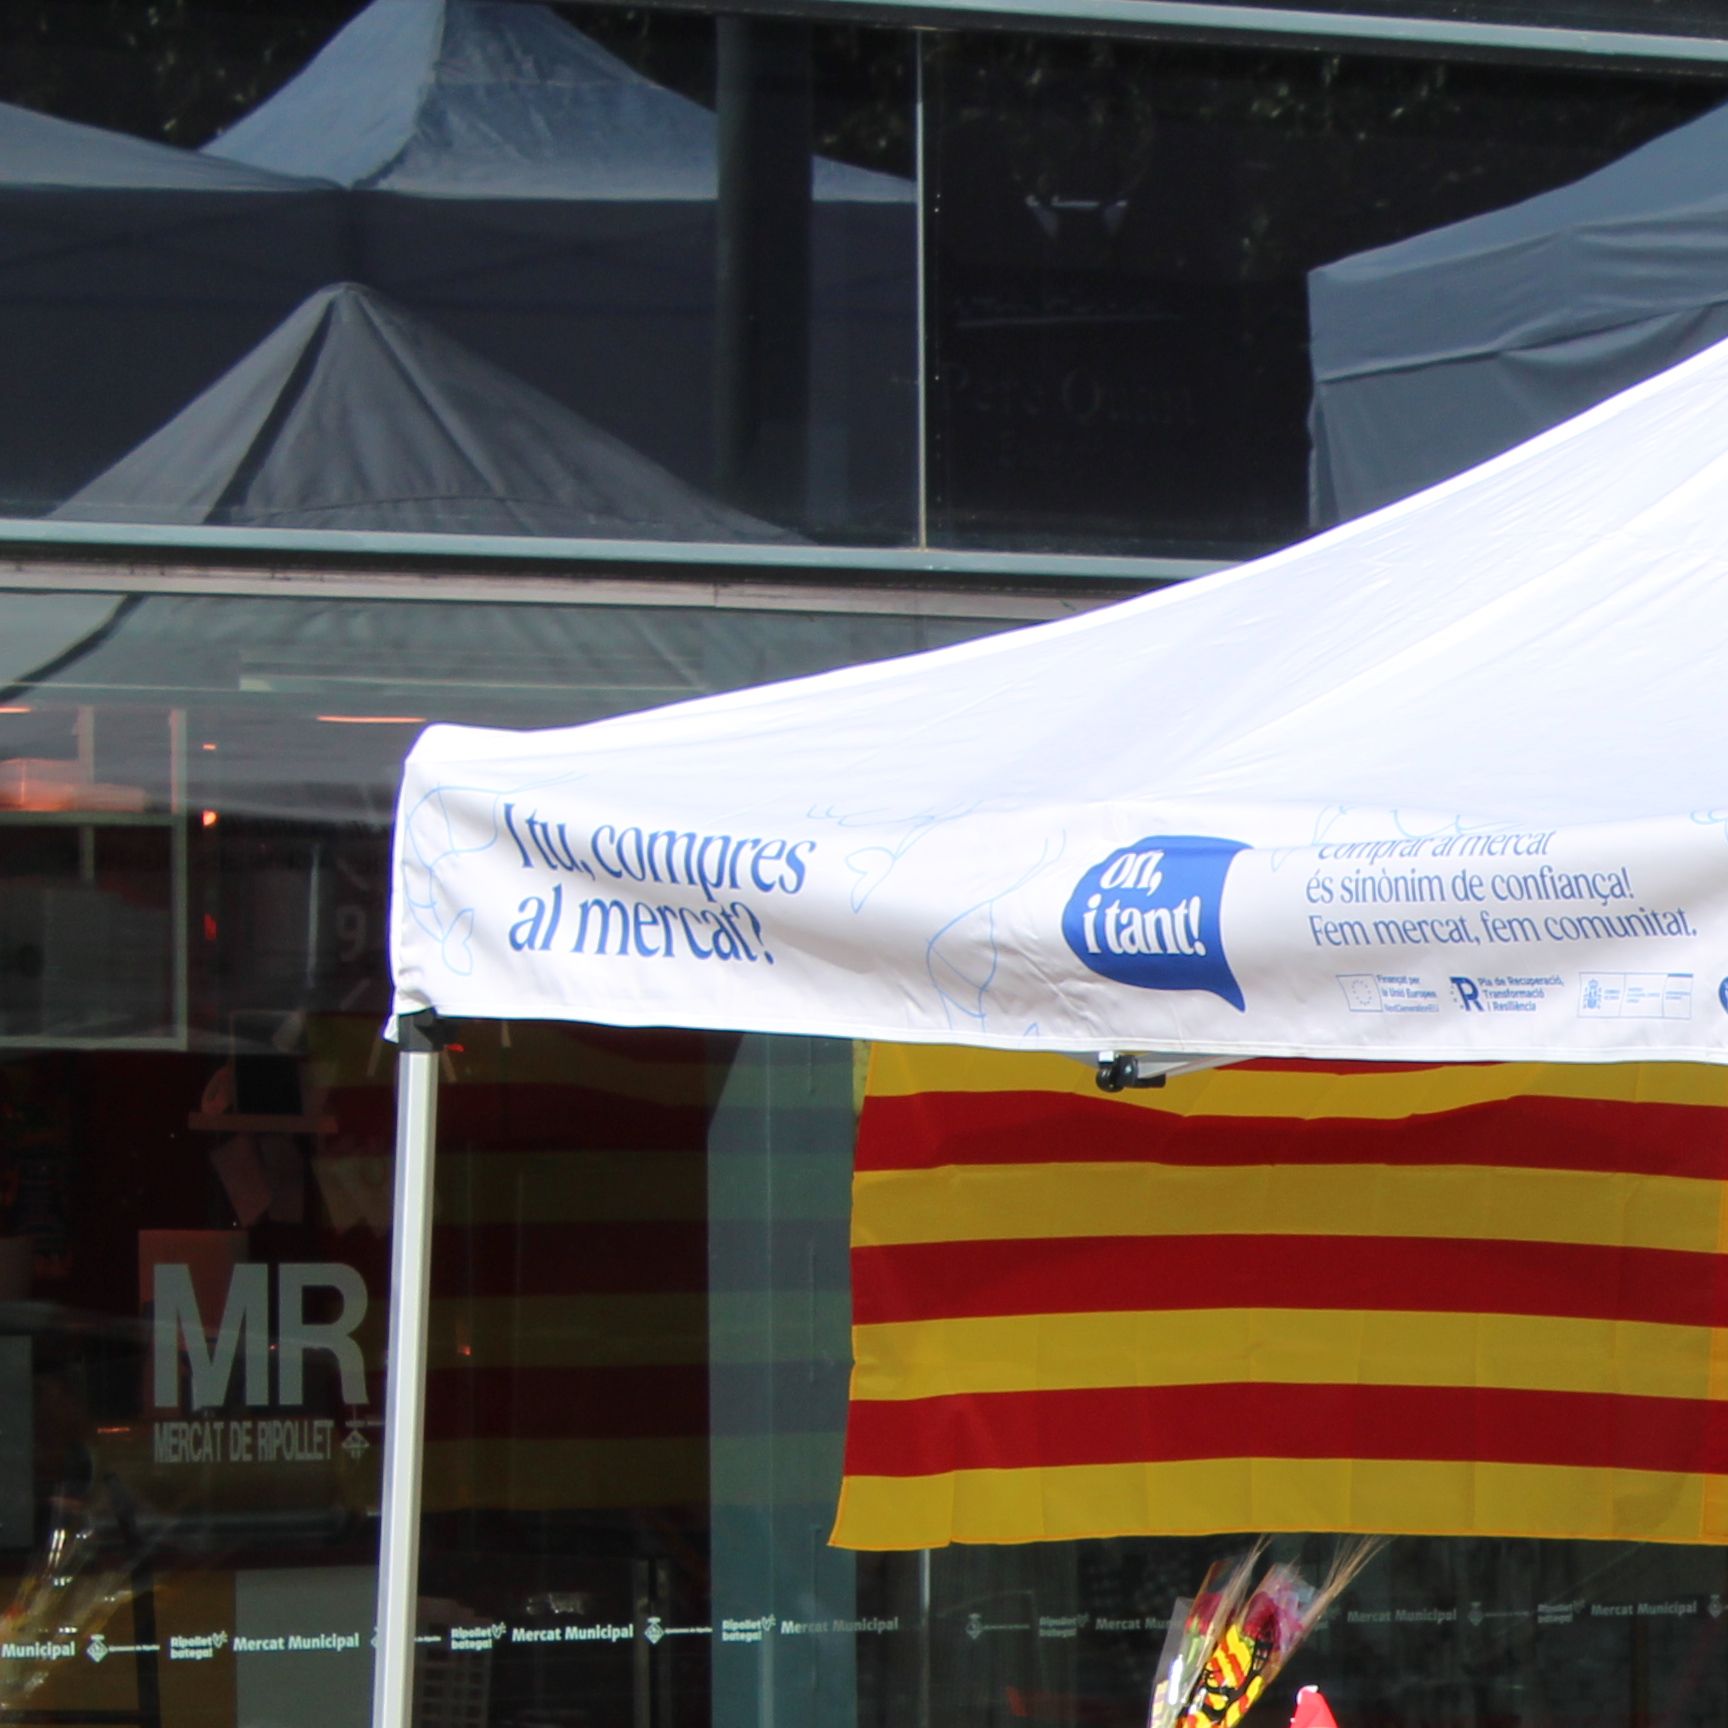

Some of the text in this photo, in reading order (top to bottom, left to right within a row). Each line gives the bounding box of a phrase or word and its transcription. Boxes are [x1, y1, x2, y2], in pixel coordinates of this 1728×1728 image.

[591, 823, 817, 902] compres
[1306, 864, 1635, 906] és sinònim de confiança!
[508, 883, 775, 965] al mercat?
[1083, 893, 1206, 956] i tant!
[1308, 907, 1698, 946] Fem mercat, fem comunitat.
[153, 1262, 369, 1408] MR
[154, 1419, 334, 1463] MERCAT DE RIPOLLET
[1096, 1617, 1140, 1630] Mercat
[1347, 1609, 1457, 1625] Mercat Municipal
[1591, 1601, 1697, 1618] Mercat Municipal
[512, 1624, 633, 1642] Mercat Municipal
[781, 1617, 899, 1634] Mercat Municipal
[1, 1641, 75, 1659] Municipal
[233, 1633, 359, 1652] Mercat Municipal
